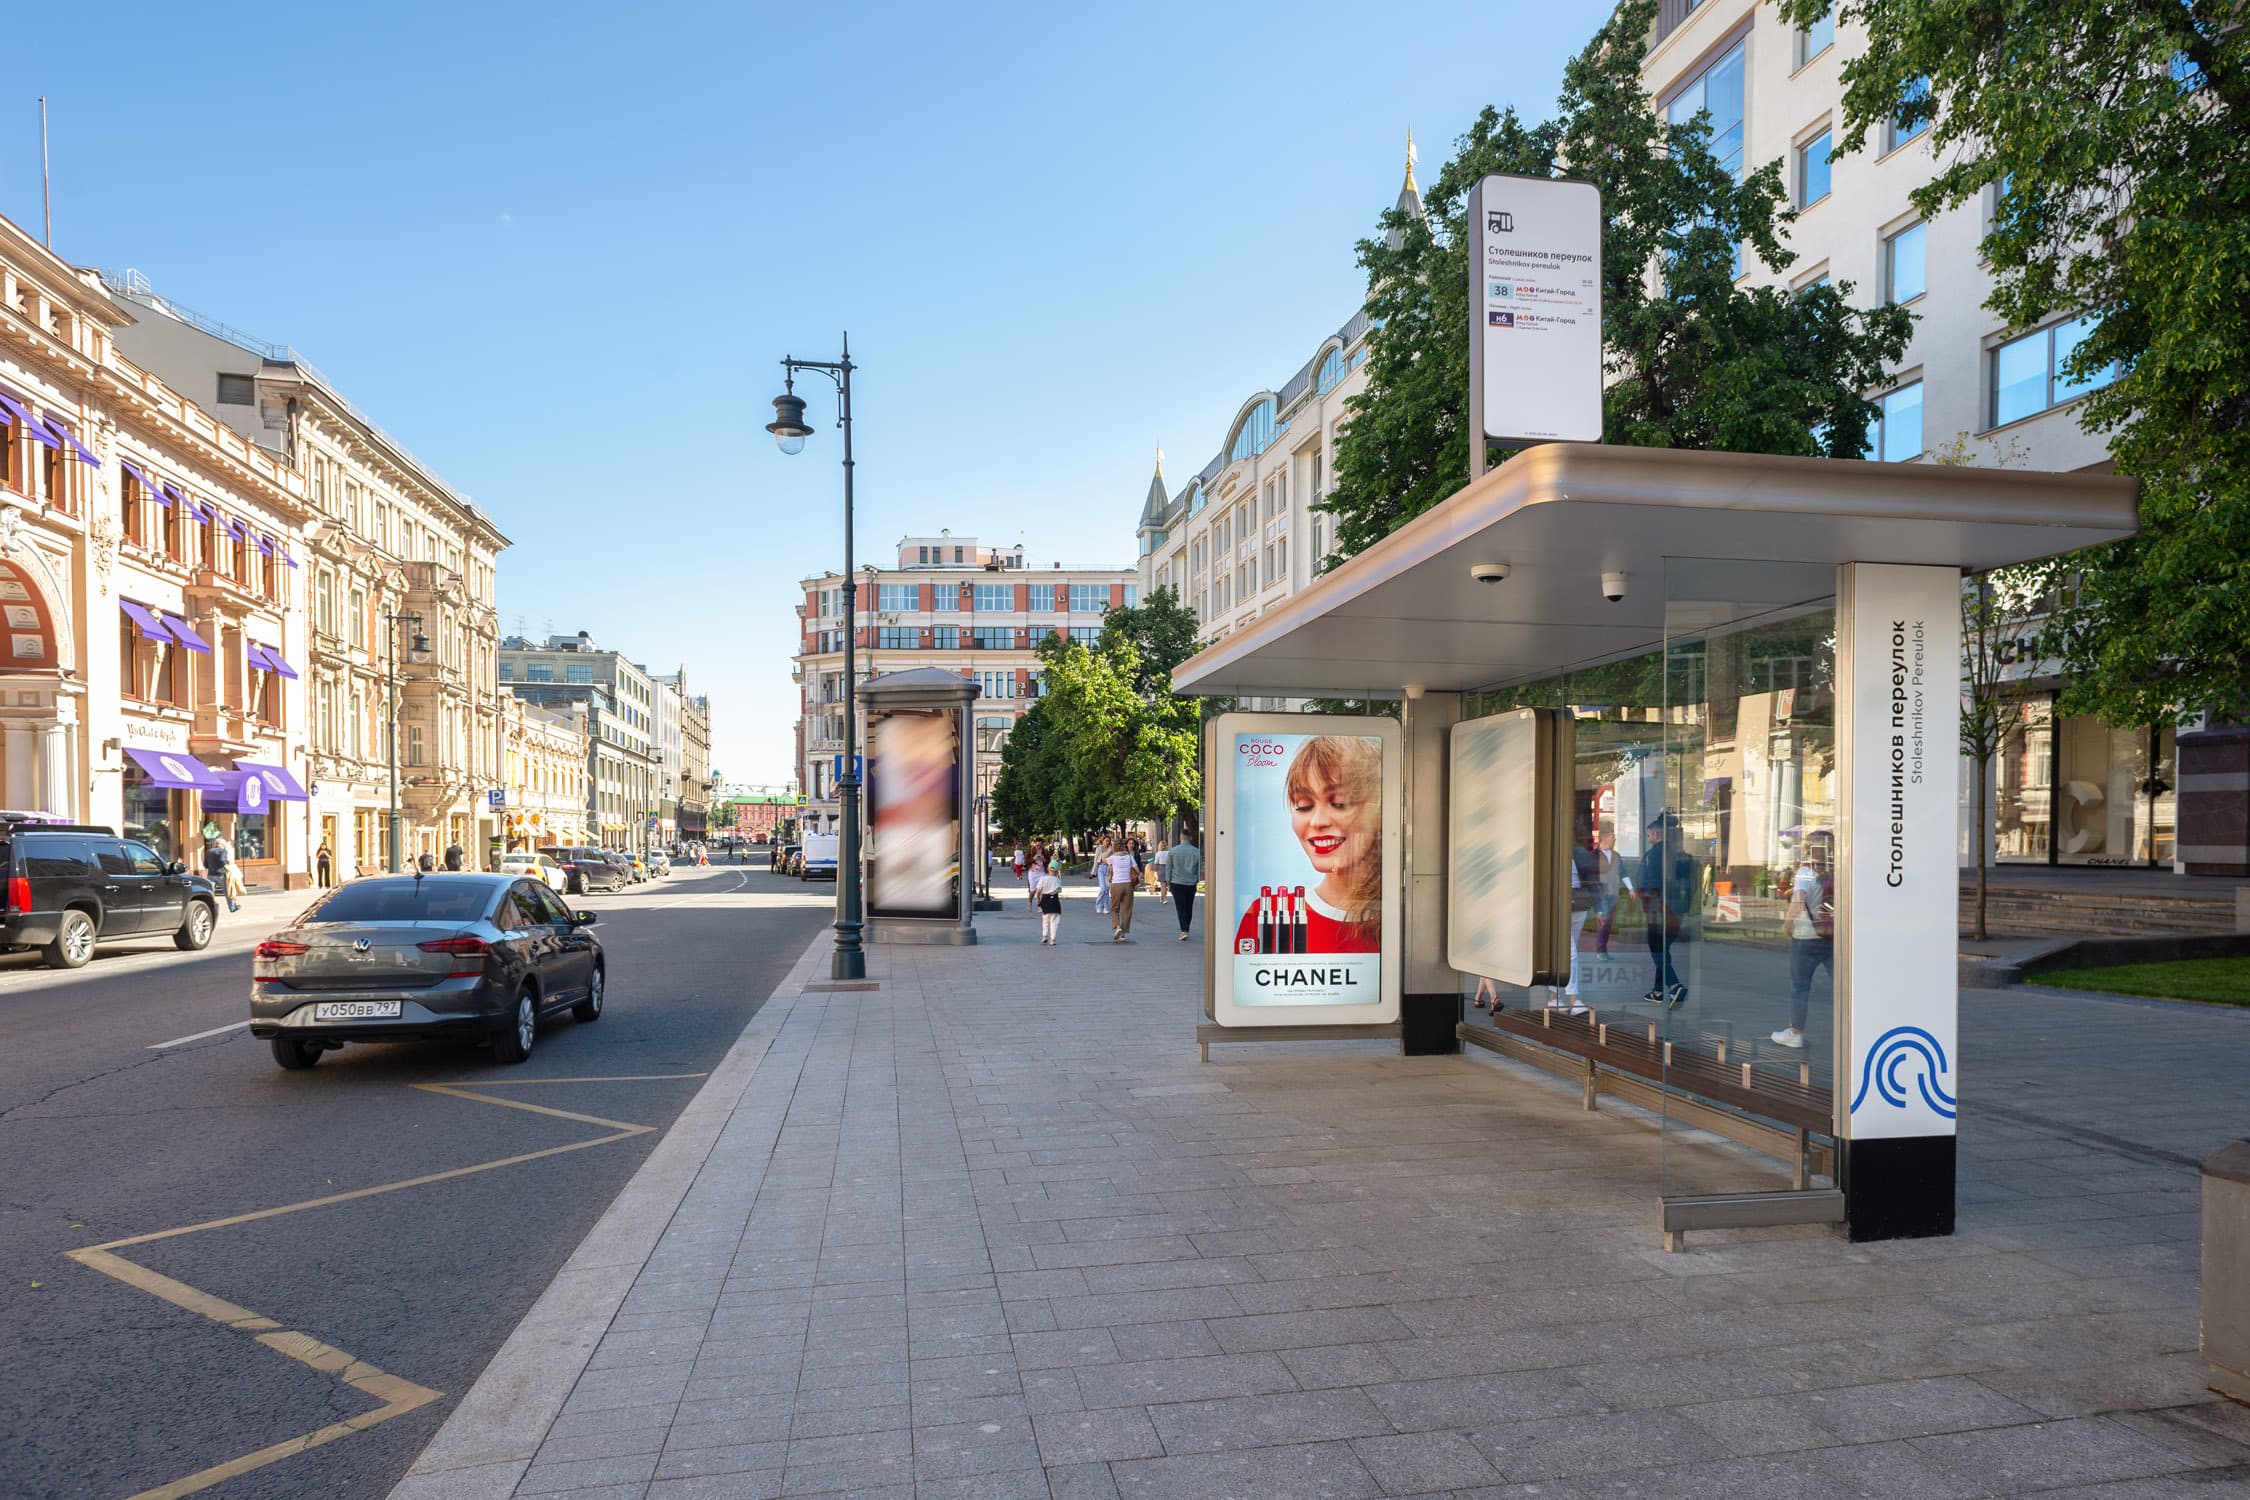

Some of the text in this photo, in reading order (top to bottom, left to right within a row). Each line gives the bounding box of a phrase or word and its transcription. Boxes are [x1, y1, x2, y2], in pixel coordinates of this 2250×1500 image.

[1488, 246, 1592, 263] Столешников переулок
[1488, 258, 1561, 270] Stoleshnikov pereulok
[1494, 286, 1508, 296] 38
[1536, 288, 1576, 297] Китай-Город
[1536, 316, 1576, 325] Китай-Город
[1911, 620, 1924, 784] Stoleshnikov Pereulok
[1239, 744, 1284, 755] COCO
[1887, 620, 1908, 887] Столешников переулок
[1255, 968, 1358, 987] CHANEL
